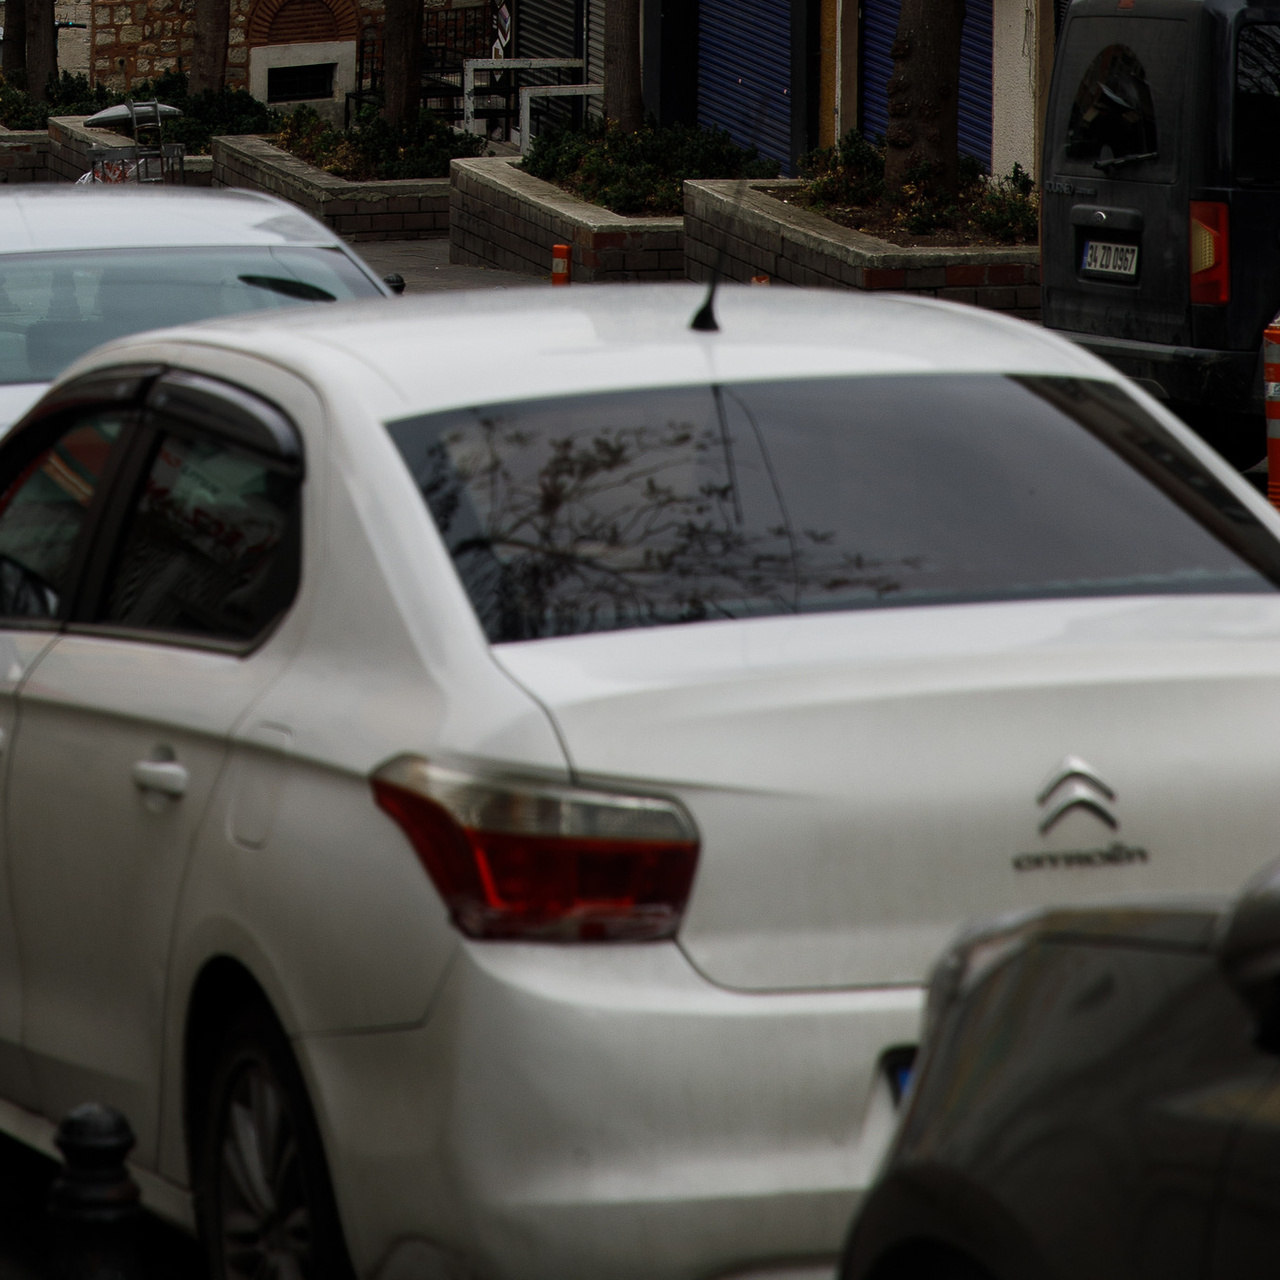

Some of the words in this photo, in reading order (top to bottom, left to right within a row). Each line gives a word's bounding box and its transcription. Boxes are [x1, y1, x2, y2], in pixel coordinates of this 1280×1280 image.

[1087, 244, 1098, 268] 34
[1099, 245, 1112, 270] ZD
[1113, 246, 1136, 272] 0967
